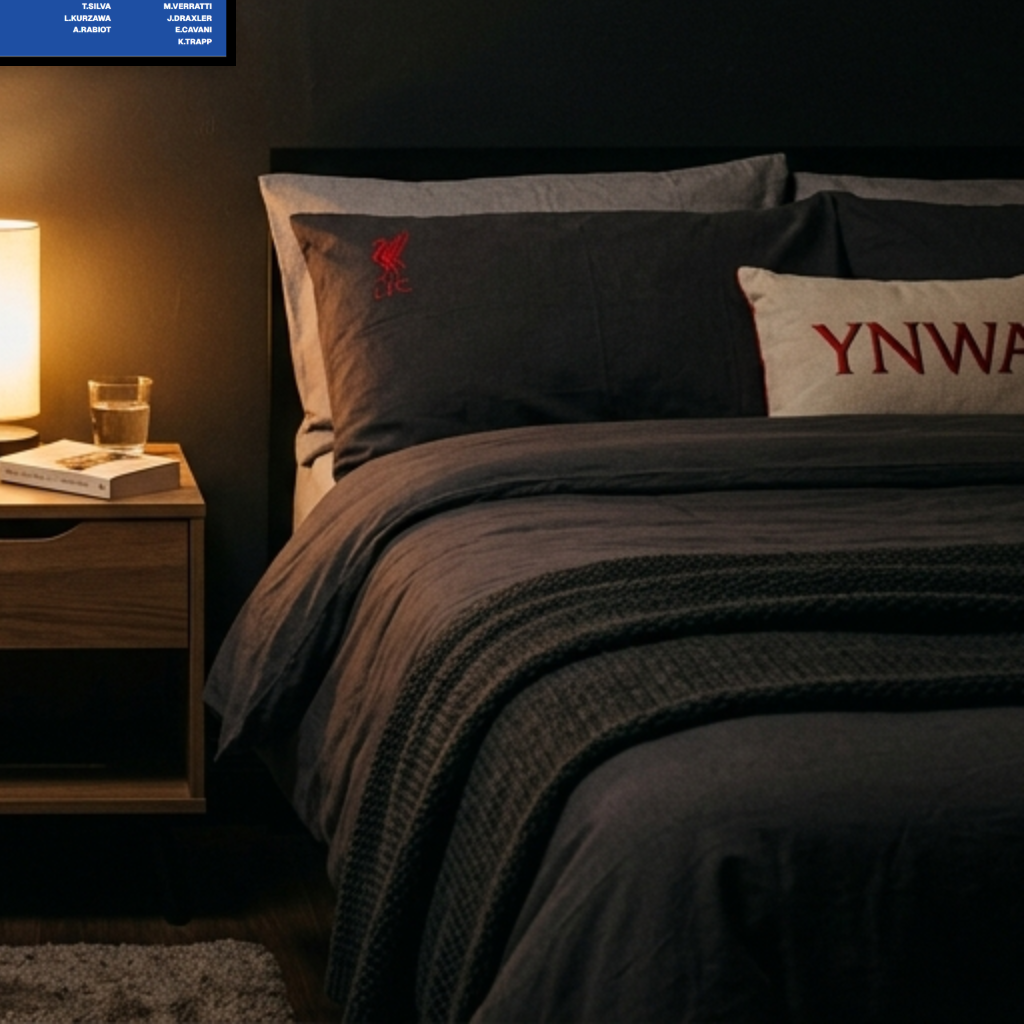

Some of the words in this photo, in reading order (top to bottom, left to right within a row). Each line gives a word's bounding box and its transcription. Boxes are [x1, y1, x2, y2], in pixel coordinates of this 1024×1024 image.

[81, 2, 112, 10] T.SILVA
[163, 2, 213, 10] M.VERRATTI
[63, 14, 112, 23] L.KURZAWA
[166, 14, 213, 23] J.DRAXLER
[72, 25, 112, 34] A.RABIOT
[174, 25, 213, 34] E.CAVANI
[177, 37, 213, 46] K.TRAPP
